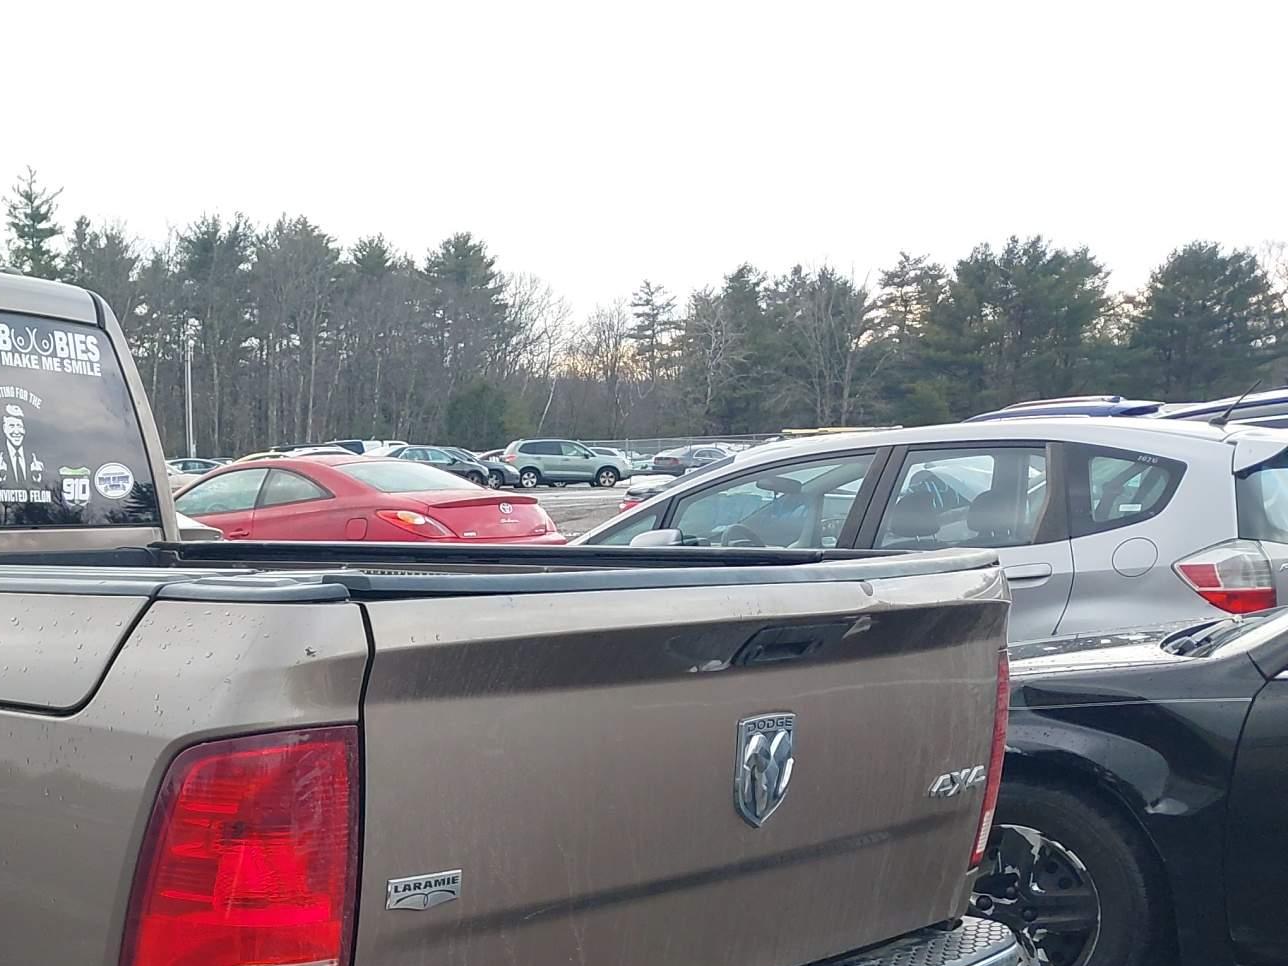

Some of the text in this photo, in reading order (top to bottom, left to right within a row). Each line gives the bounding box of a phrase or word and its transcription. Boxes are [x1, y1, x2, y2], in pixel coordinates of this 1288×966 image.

[0, 351, 102, 376] MAKE ME SMILE
[15, 387, 28, 401] FOR
[29, 392, 42, 409] THE
[29, 490, 52, 503] FELON
[746, 717, 793, 732] DODGE
[393, 876, 460, 894] LARAMIE
